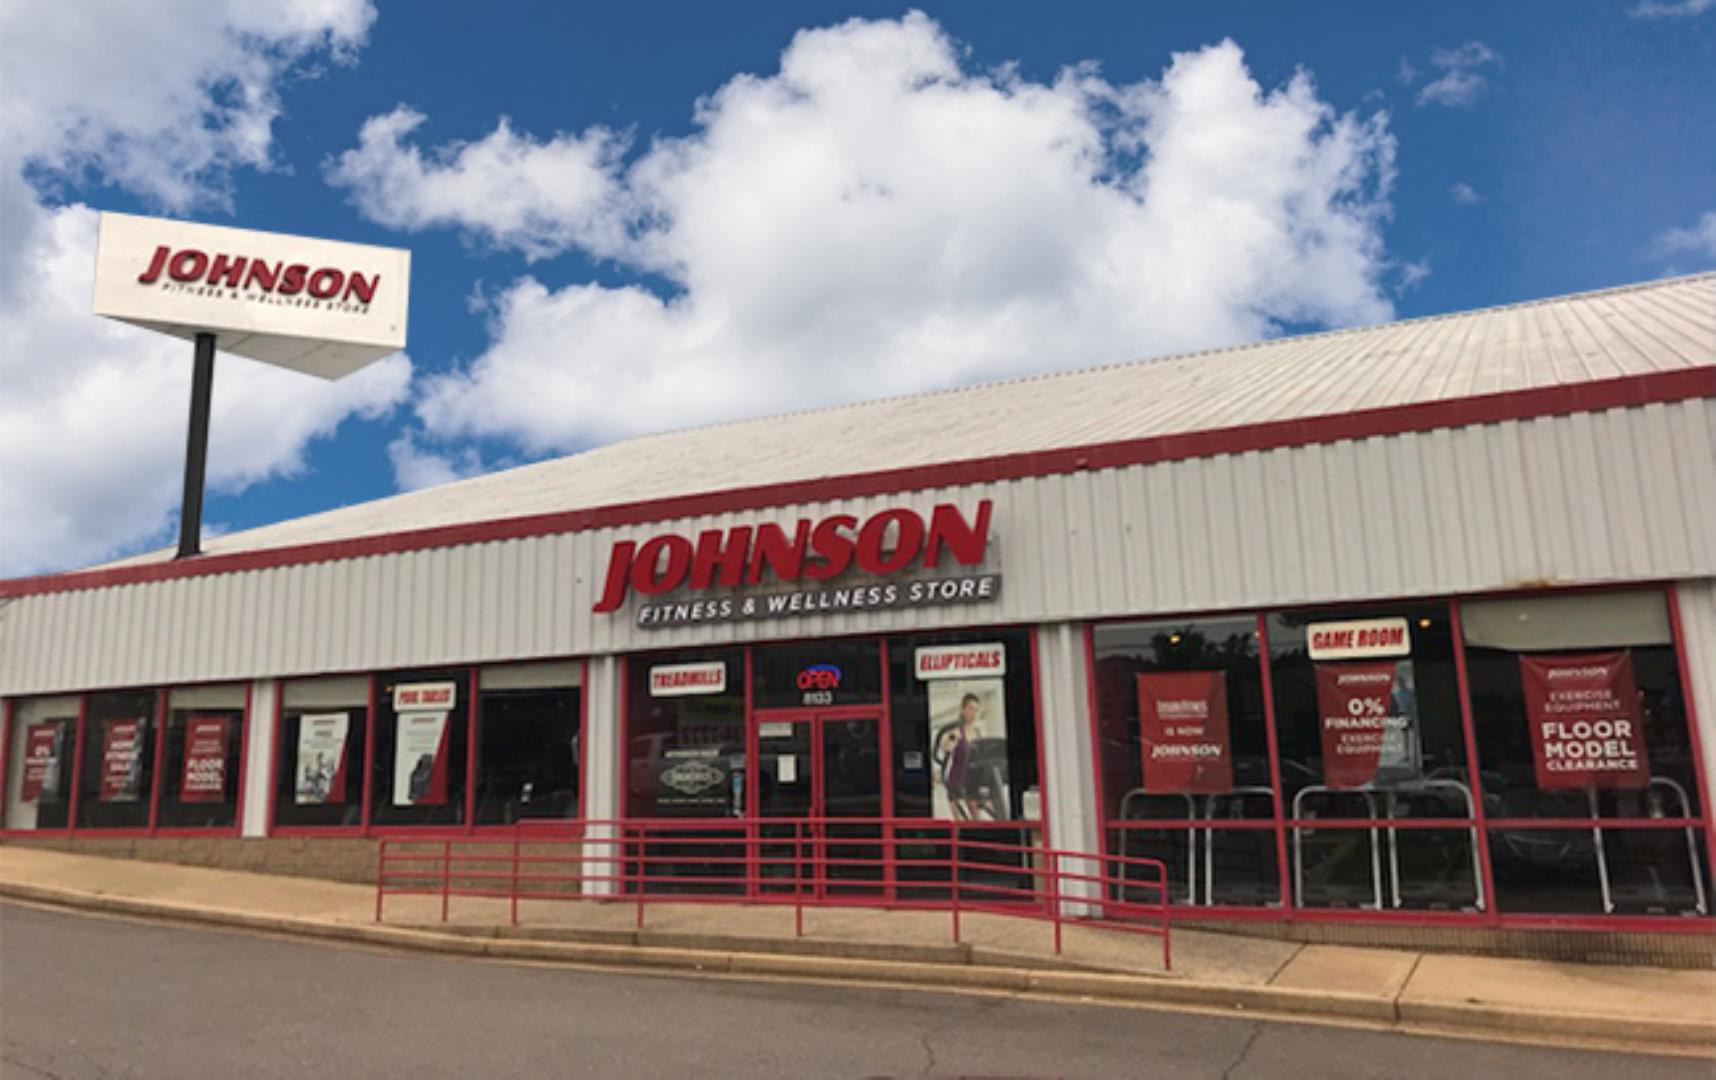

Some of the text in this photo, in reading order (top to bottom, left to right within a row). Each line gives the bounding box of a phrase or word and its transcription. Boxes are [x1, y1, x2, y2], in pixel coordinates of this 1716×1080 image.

[138, 245, 380, 304] JOHNSON
[162, 283, 223, 298] FITNESS
[245, 293, 320, 309] WELLNESS
[326, 301, 369, 315] STORE
[592, 500, 993, 614] JOHNSON
[639, 577, 993, 624] FITNESS & WELLNESS STORE
[1312, 627, 1404, 649] GAME ROOM
[920, 651, 1001, 671] ELLIPTICALS
[653, 669, 722, 688] TREADMILLS
[796, 669, 839, 689] OPEN
[1549, 690, 1611, 701] EXERCISE
[1347, 698, 1385, 715] 0%
[1544, 700, 1620, 712] EQUIPMENT
[1324, 717, 1408, 729] FINANCING
[1542, 720, 1632, 739] FLOOR
[1151, 743, 1222, 758] JOHNSON
[1545, 740, 1636, 758] MODEL
[1545, 759, 1638, 771] CLEARANCE
